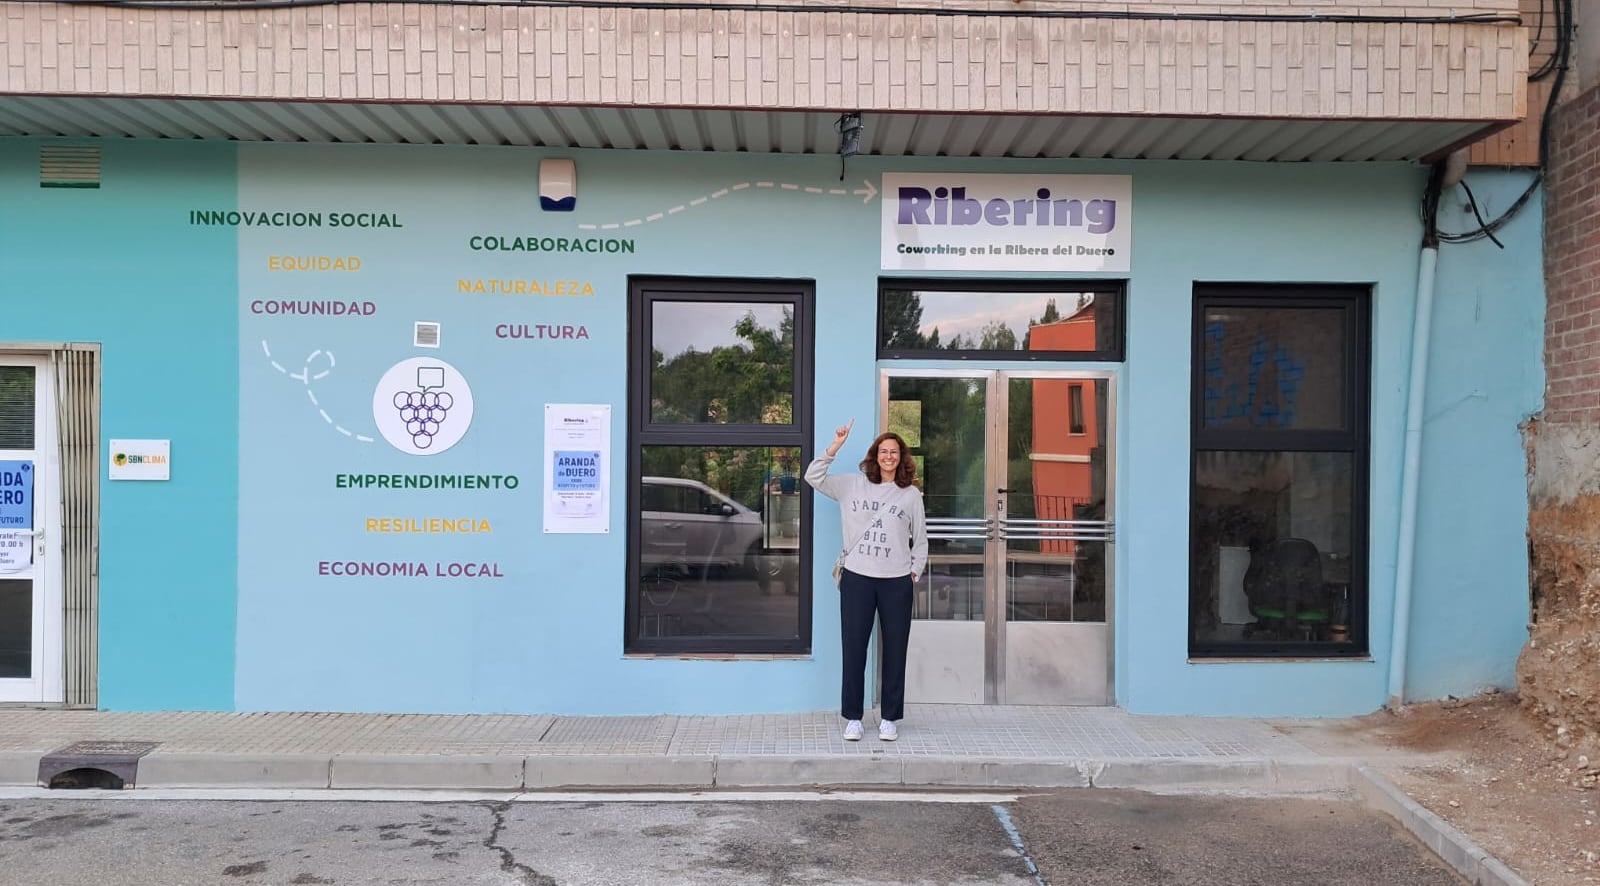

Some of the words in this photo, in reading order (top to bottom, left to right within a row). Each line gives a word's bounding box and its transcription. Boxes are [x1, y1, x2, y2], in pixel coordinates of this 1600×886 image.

[897, 187, 1117, 234] Ribering
[189, 210, 322, 227] INNOVACION
[328, 212, 403, 228] SOCIAL
[469, 235, 635, 254] COLABORACION
[897, 243, 967, 257] Coworking
[970, 247, 986, 255] en
[989, 244, 1002, 255] la
[1005, 244, 1049, 256] Ribera
[1052, 244, 1073, 256] del
[1076, 245, 1115, 256] Duero
[268, 255, 362, 271] EQUIDAD
[457, 279, 594, 296] NATURALEZA
[250, 299, 376, 316] COMUNIDAD
[495, 324, 590, 340] CULTURA
[128, 455, 166, 464] SBNCLIMA
[559, 458, 595, 467] ARANDA
[566, 468, 596, 477] DUERO
[335, 473, 520, 490] EMPRENDIMIENTO
[365, 518, 493, 534] RESILIENCIA
[864, 531, 887, 543] BIG
[859, 544, 892, 558] CITY
[318, 561, 429, 577] ECONOMIA
[436, 562, 504, 578] LOCAL
